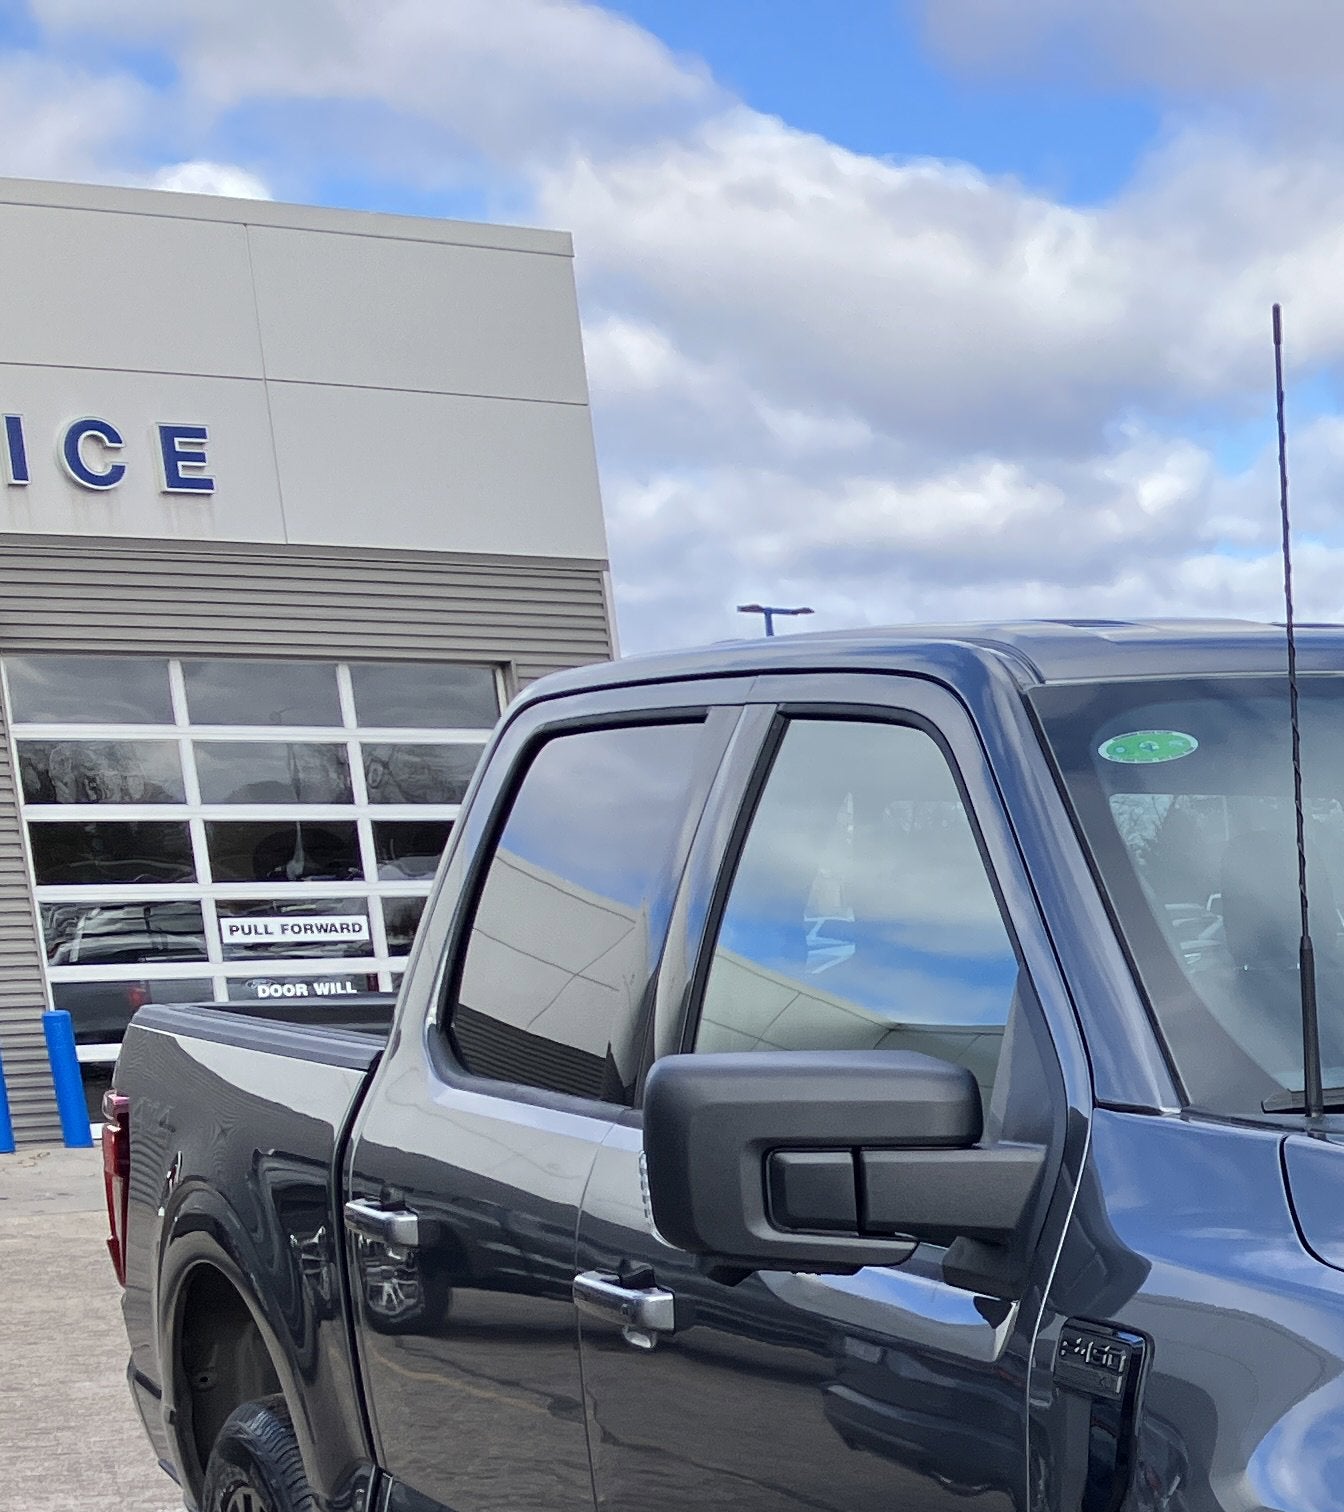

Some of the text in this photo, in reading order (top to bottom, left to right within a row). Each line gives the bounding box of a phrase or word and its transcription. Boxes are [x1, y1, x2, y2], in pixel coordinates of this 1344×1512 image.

[3, 415, 213, 492] ICE
[228, 922, 363, 936] PULL FORWARD
[256, 983, 309, 998] DOOR
[313, 981, 358, 995] WILL
